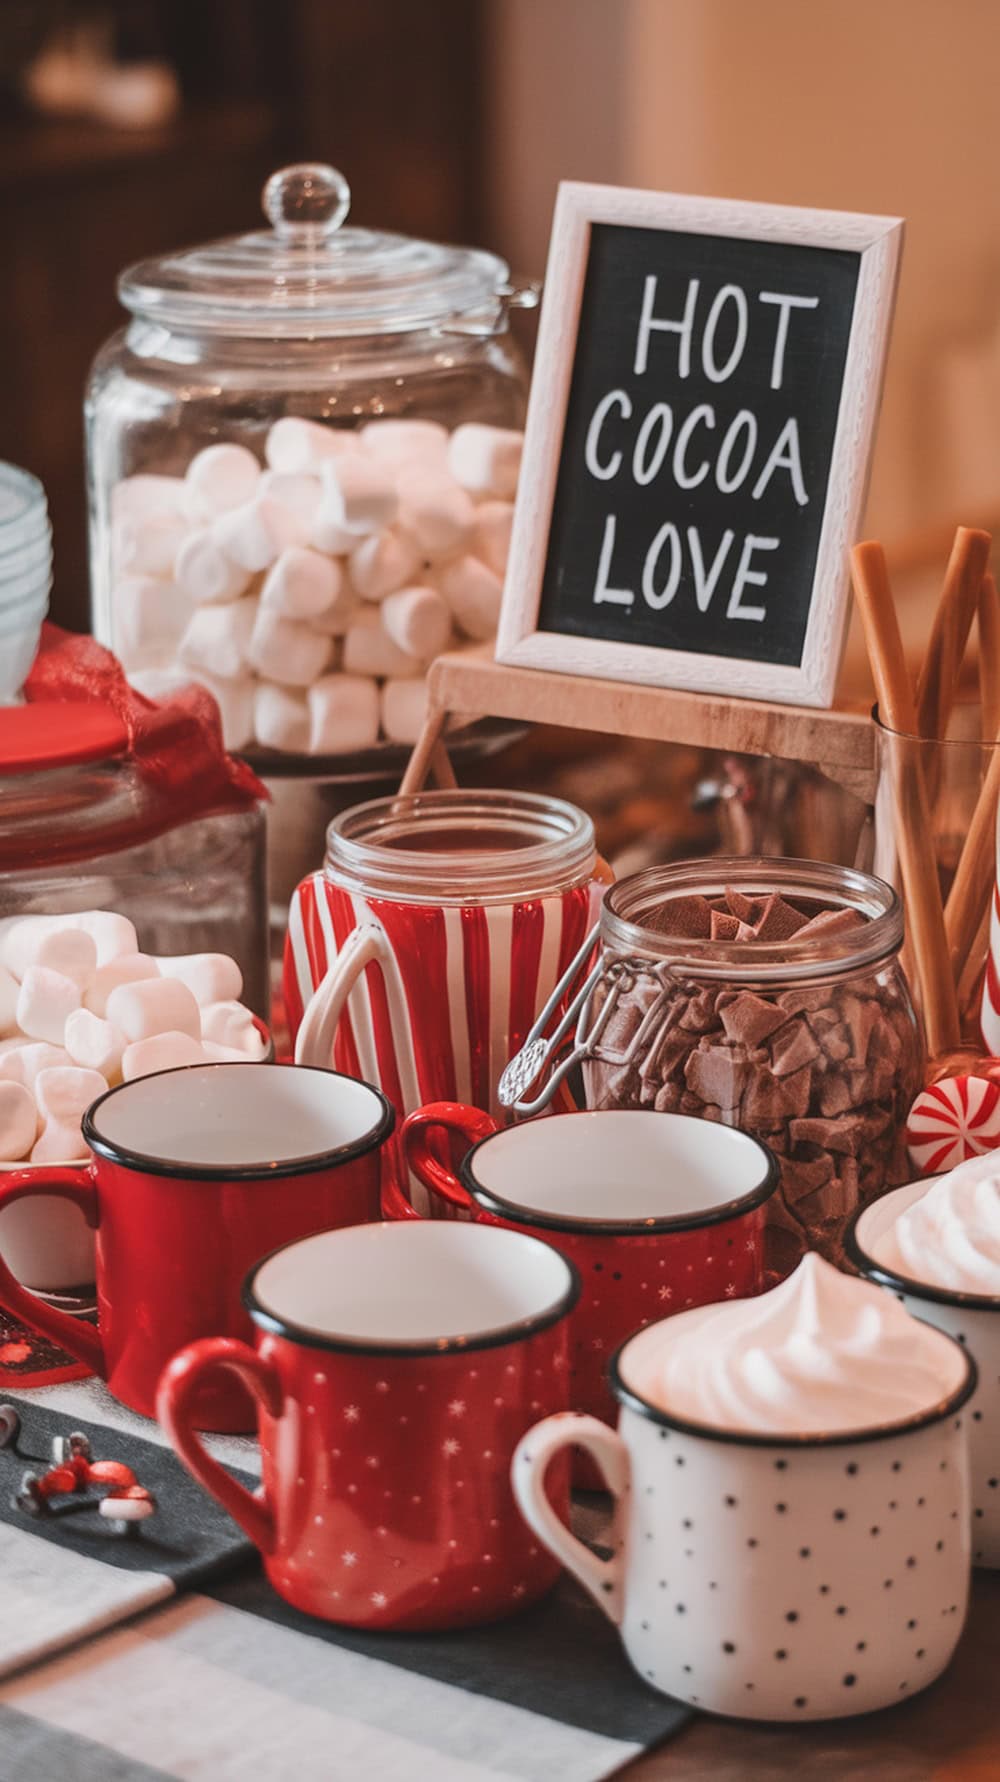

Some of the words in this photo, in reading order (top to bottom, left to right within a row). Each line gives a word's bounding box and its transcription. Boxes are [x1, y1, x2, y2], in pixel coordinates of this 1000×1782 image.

[634, 275, 819, 390] HOT
[585, 389, 809, 506] COCOA
[593, 515, 780, 622] LOVE
